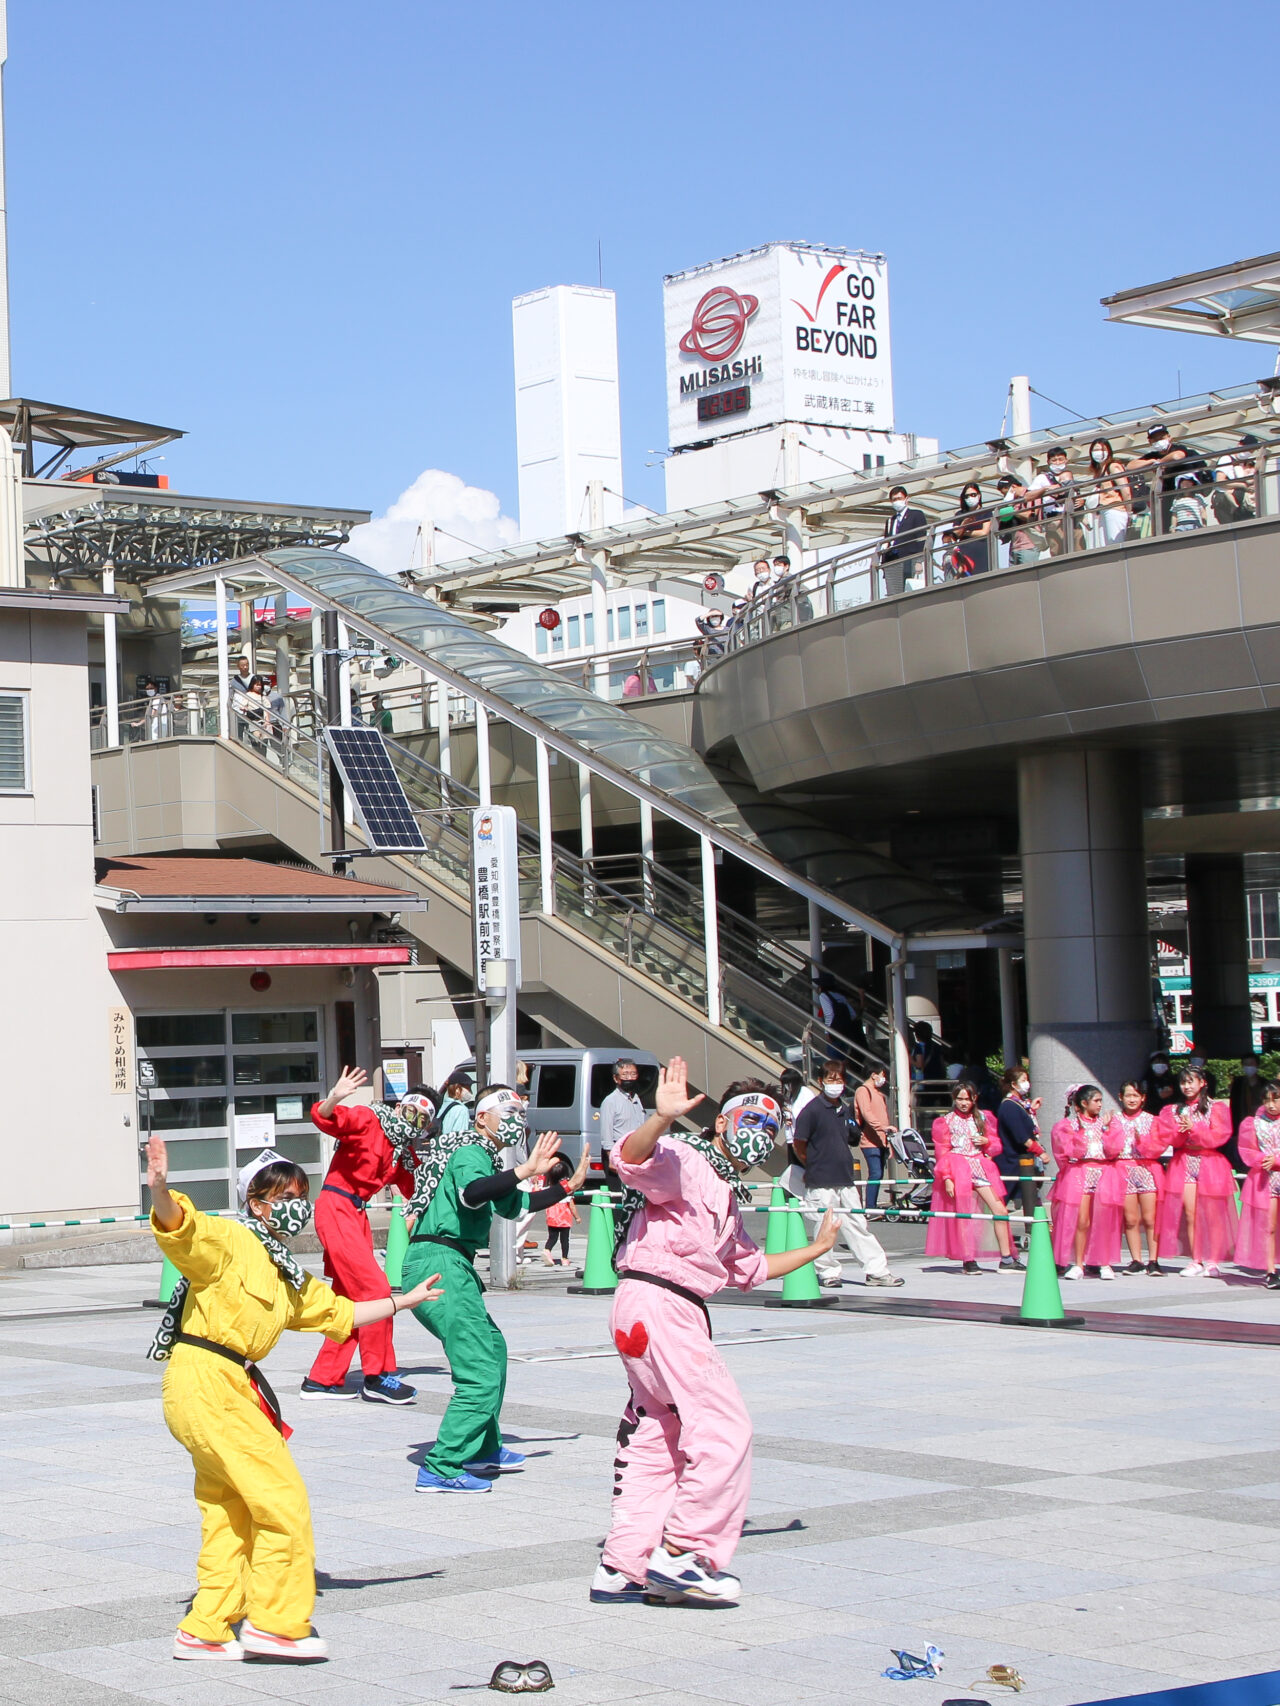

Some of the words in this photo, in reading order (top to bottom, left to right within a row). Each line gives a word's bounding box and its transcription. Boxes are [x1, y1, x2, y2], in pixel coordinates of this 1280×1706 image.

[846, 274, 875, 300] GO
[836, 302, 876, 330] FAR
[796, 326, 878, 359] BEYOND
[804, 394, 875, 414] 武蔵精密工業
[490, 857, 501, 959] 愛知県豊橋警察署
[113, 1012, 126, 1090] みかじめ相談所
